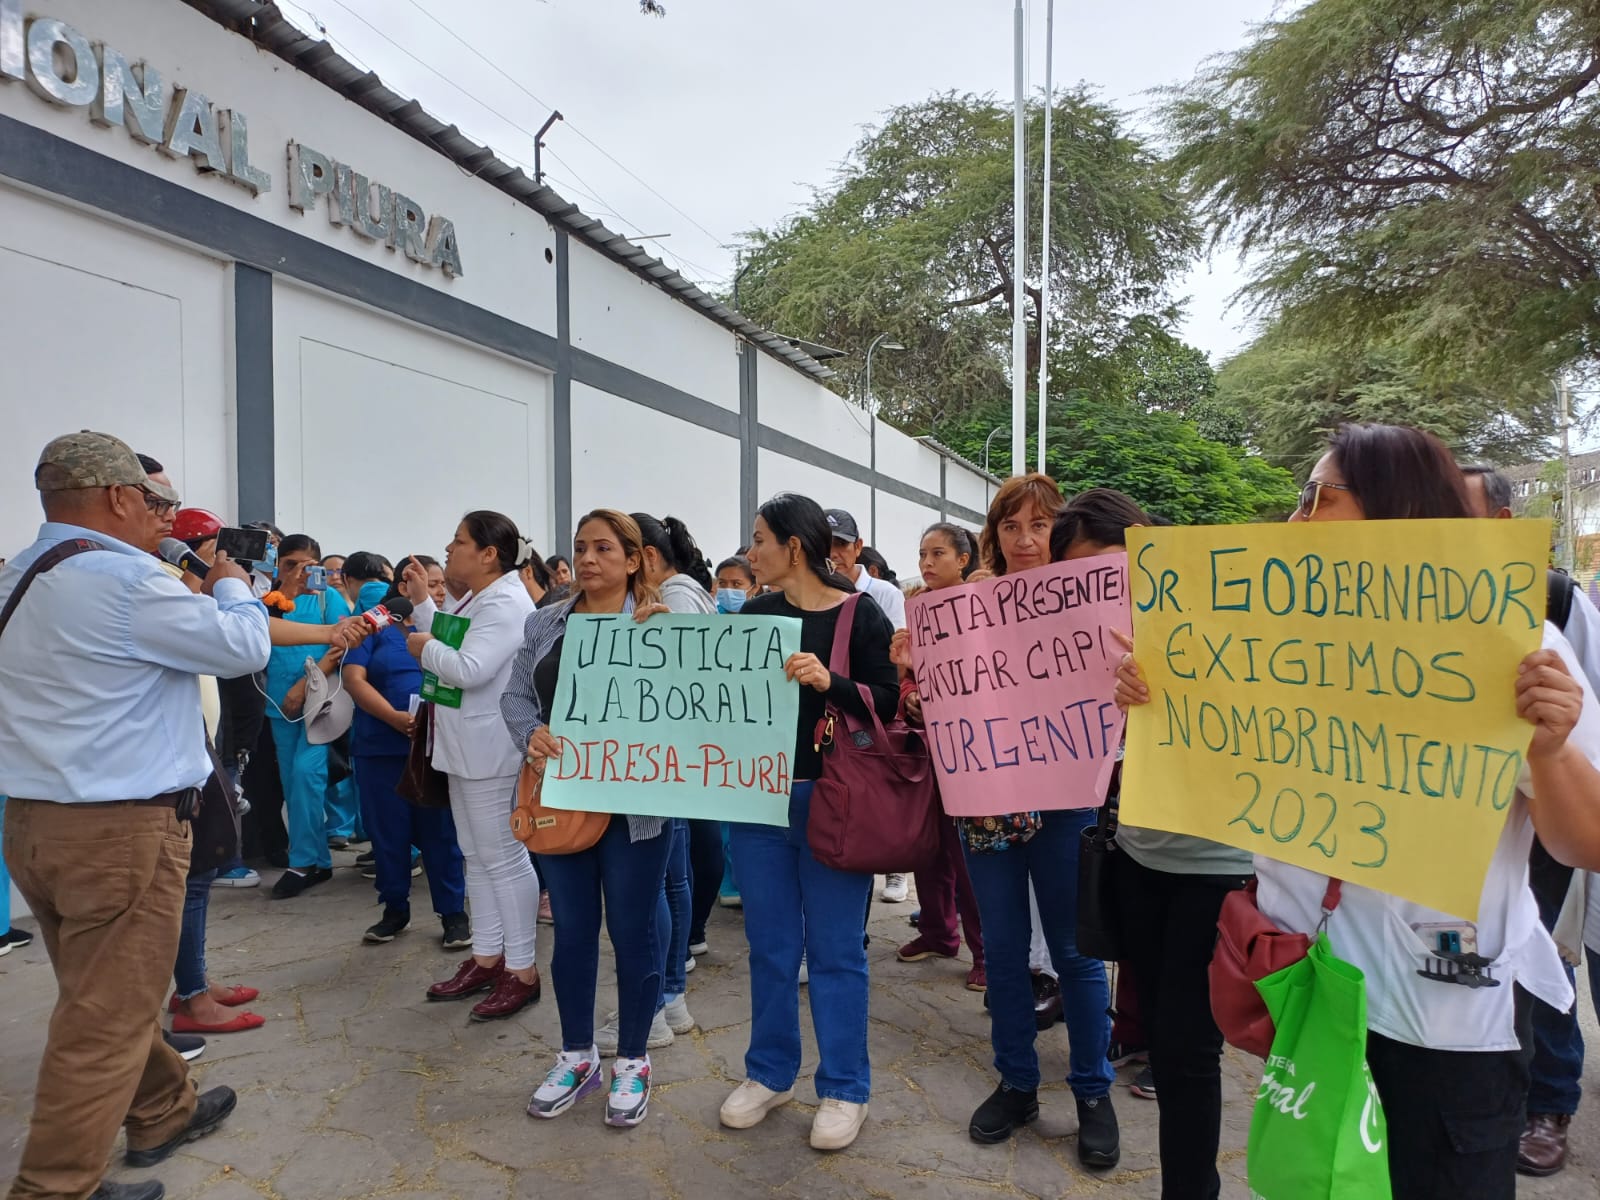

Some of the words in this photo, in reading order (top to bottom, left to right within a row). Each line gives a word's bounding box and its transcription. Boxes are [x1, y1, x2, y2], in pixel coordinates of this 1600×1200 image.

[287, 139, 464, 279] PIURA
[992, 565, 1125, 626] PRESENTE!
[1209, 546, 1541, 630] GOBERNADOR
[577, 617, 785, 673] JUSTICIA
[1026, 625, 1110, 680] CAP!
[1165, 622, 1476, 702] EXIGIMOS
[564, 673, 774, 727] LABORAL!
[550, 735, 790, 796] DIRESA-PIURA
[1158, 688, 1522, 811] NOMBRAMIENTO
[1228, 771, 1389, 869] 2023
